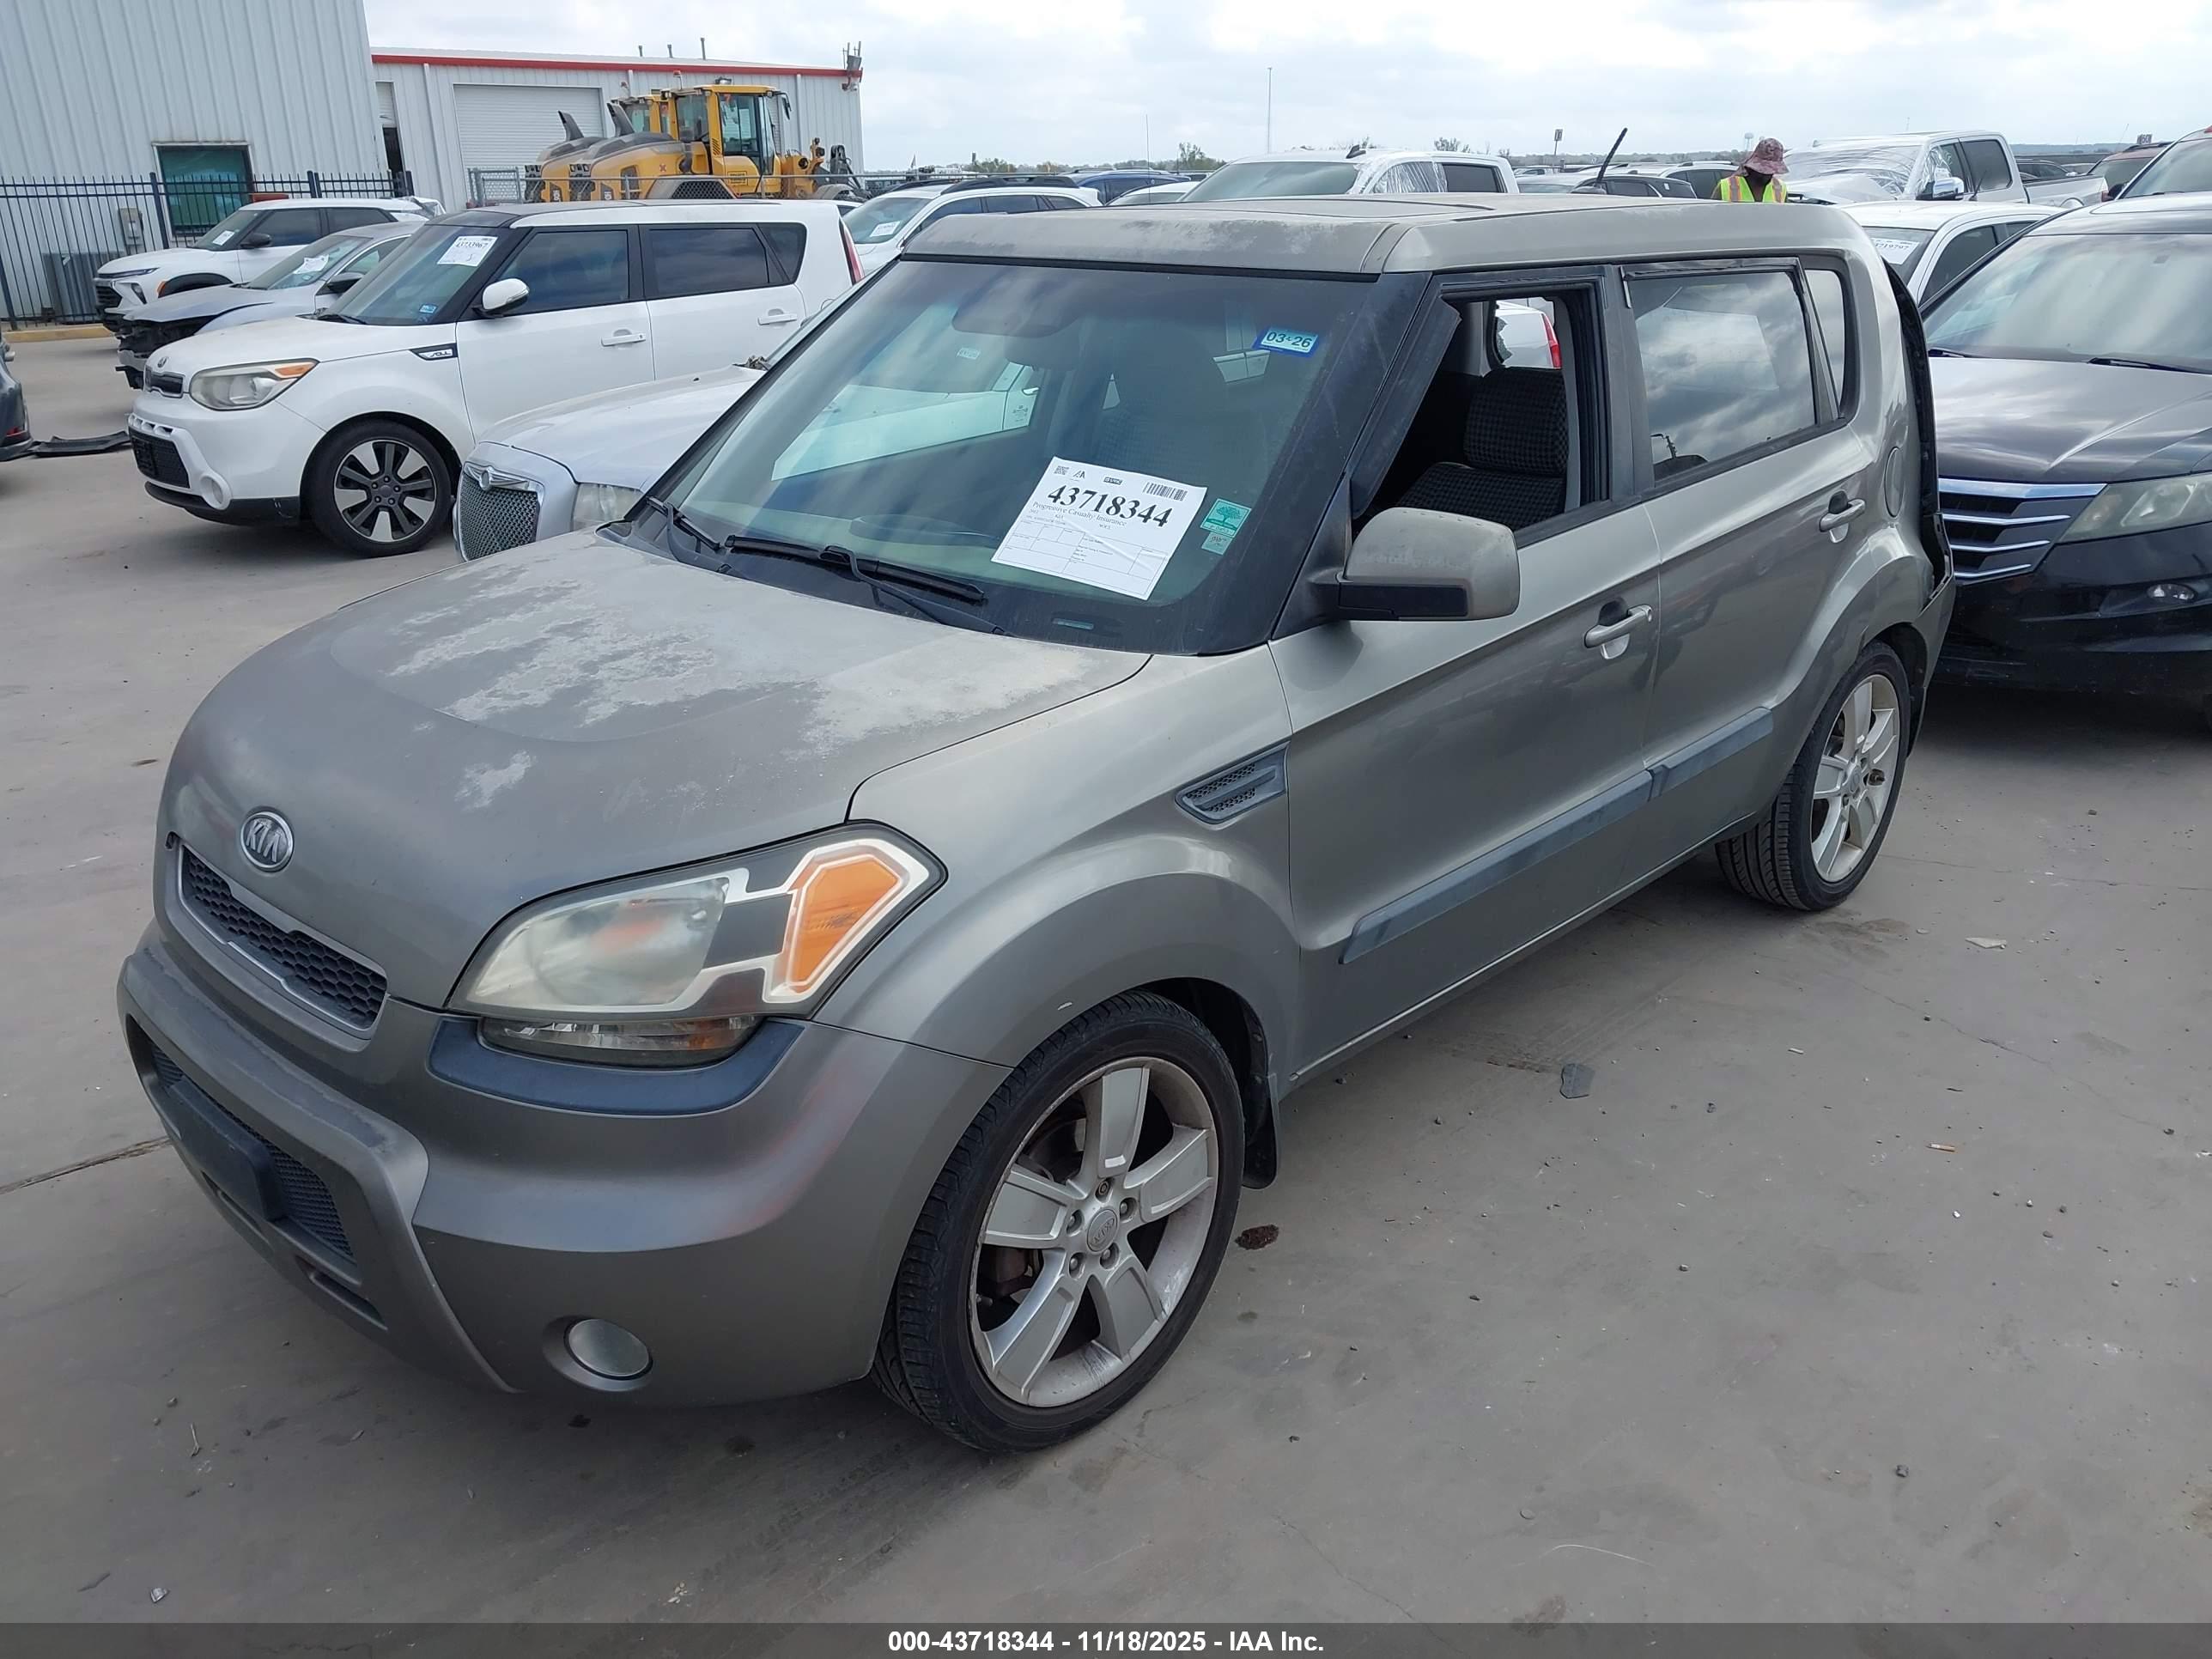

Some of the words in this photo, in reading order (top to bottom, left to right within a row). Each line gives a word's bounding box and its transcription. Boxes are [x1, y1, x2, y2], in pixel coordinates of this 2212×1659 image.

[1032, 501, 1068, 514] Progressive
[1067, 507, 1096, 520] Casualty
[1096, 514, 1127, 526] Insurance
[1048, 484, 1173, 527] 43718344
[246, 817, 283, 862] KIA
